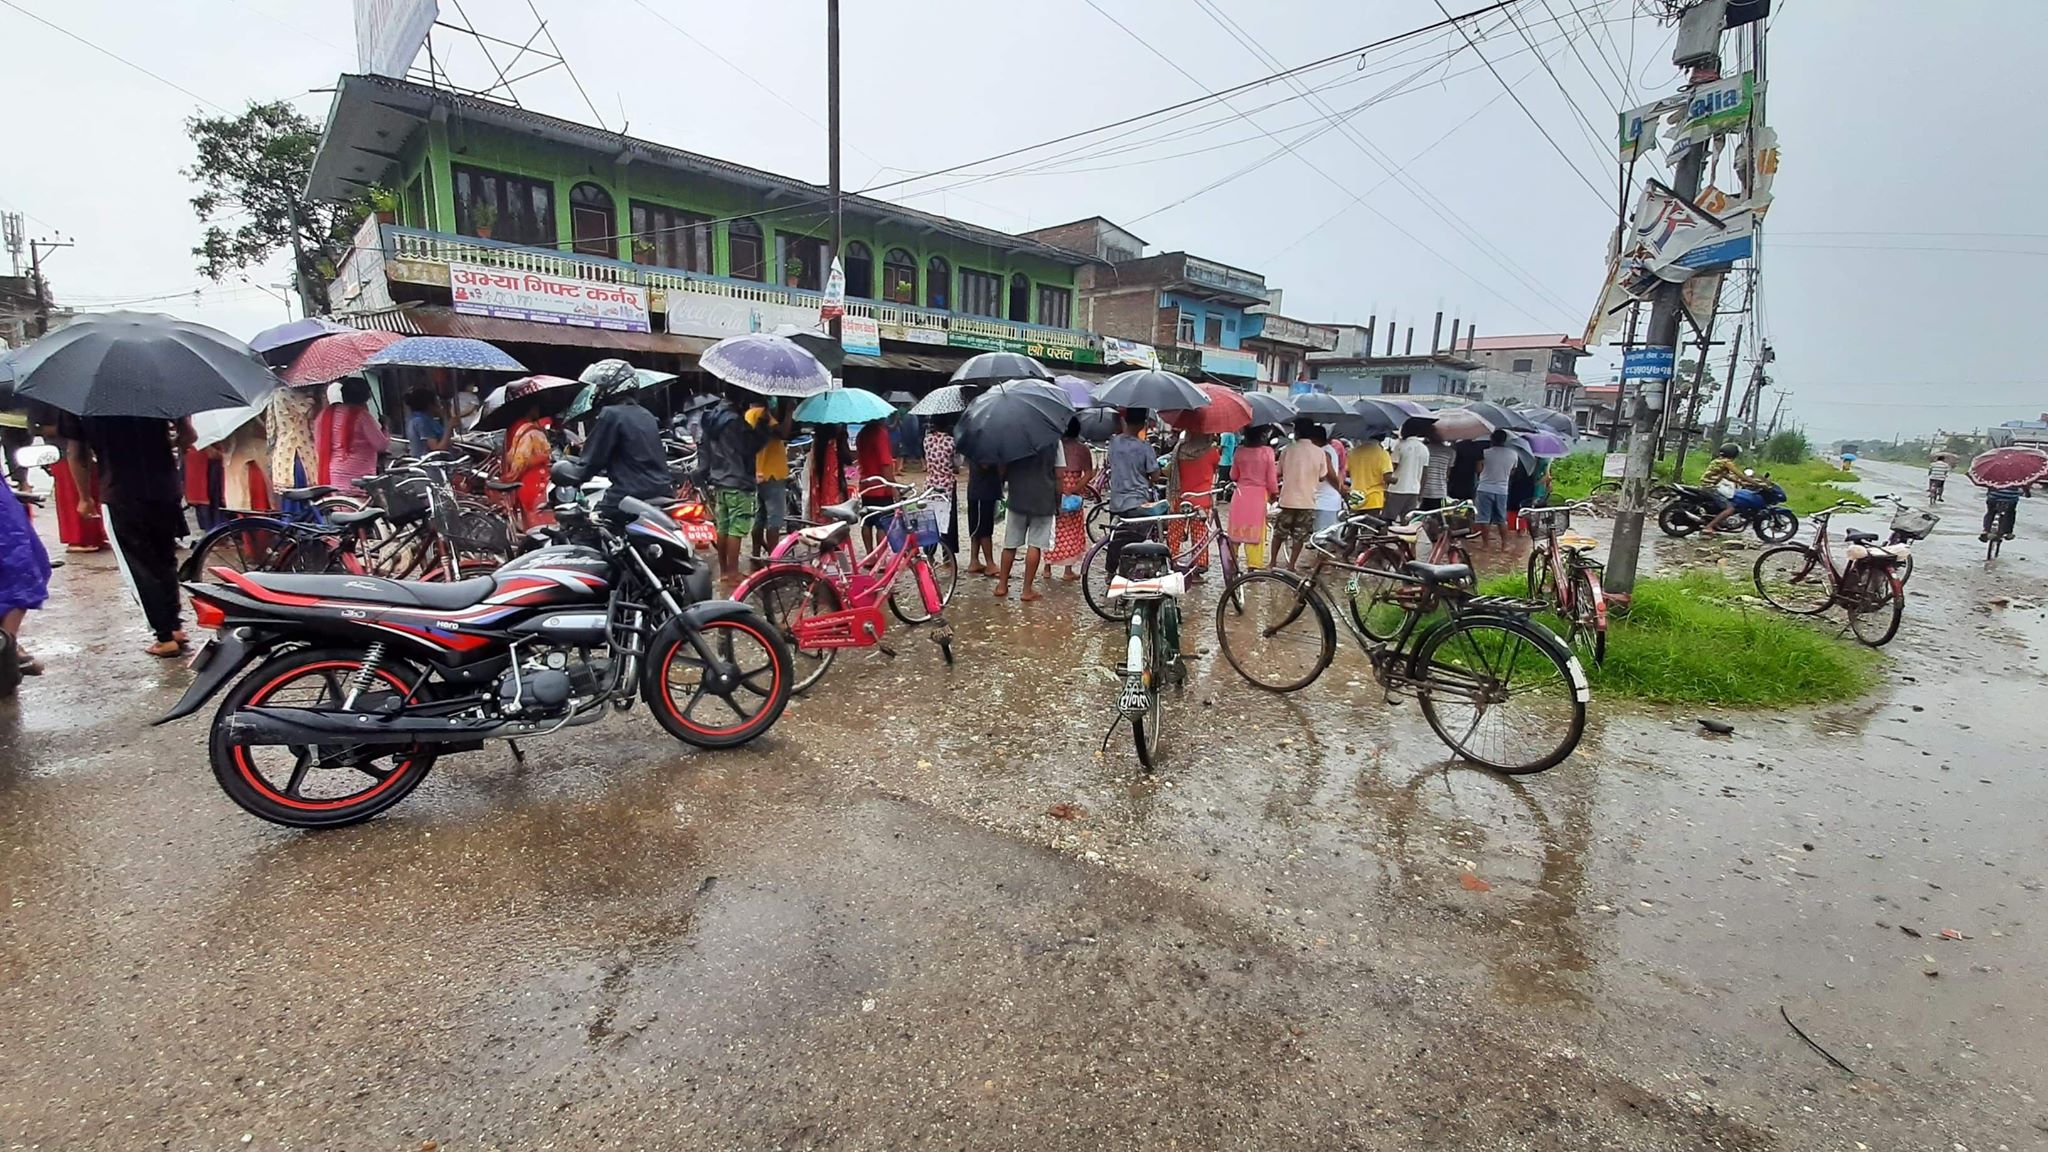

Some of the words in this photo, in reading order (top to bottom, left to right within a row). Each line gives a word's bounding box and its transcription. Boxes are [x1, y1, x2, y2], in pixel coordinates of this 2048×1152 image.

[524, 275, 582, 298] गिफ्ट
[585, 286, 644, 311] कर्नर
[435, 620, 460, 631] Hero
